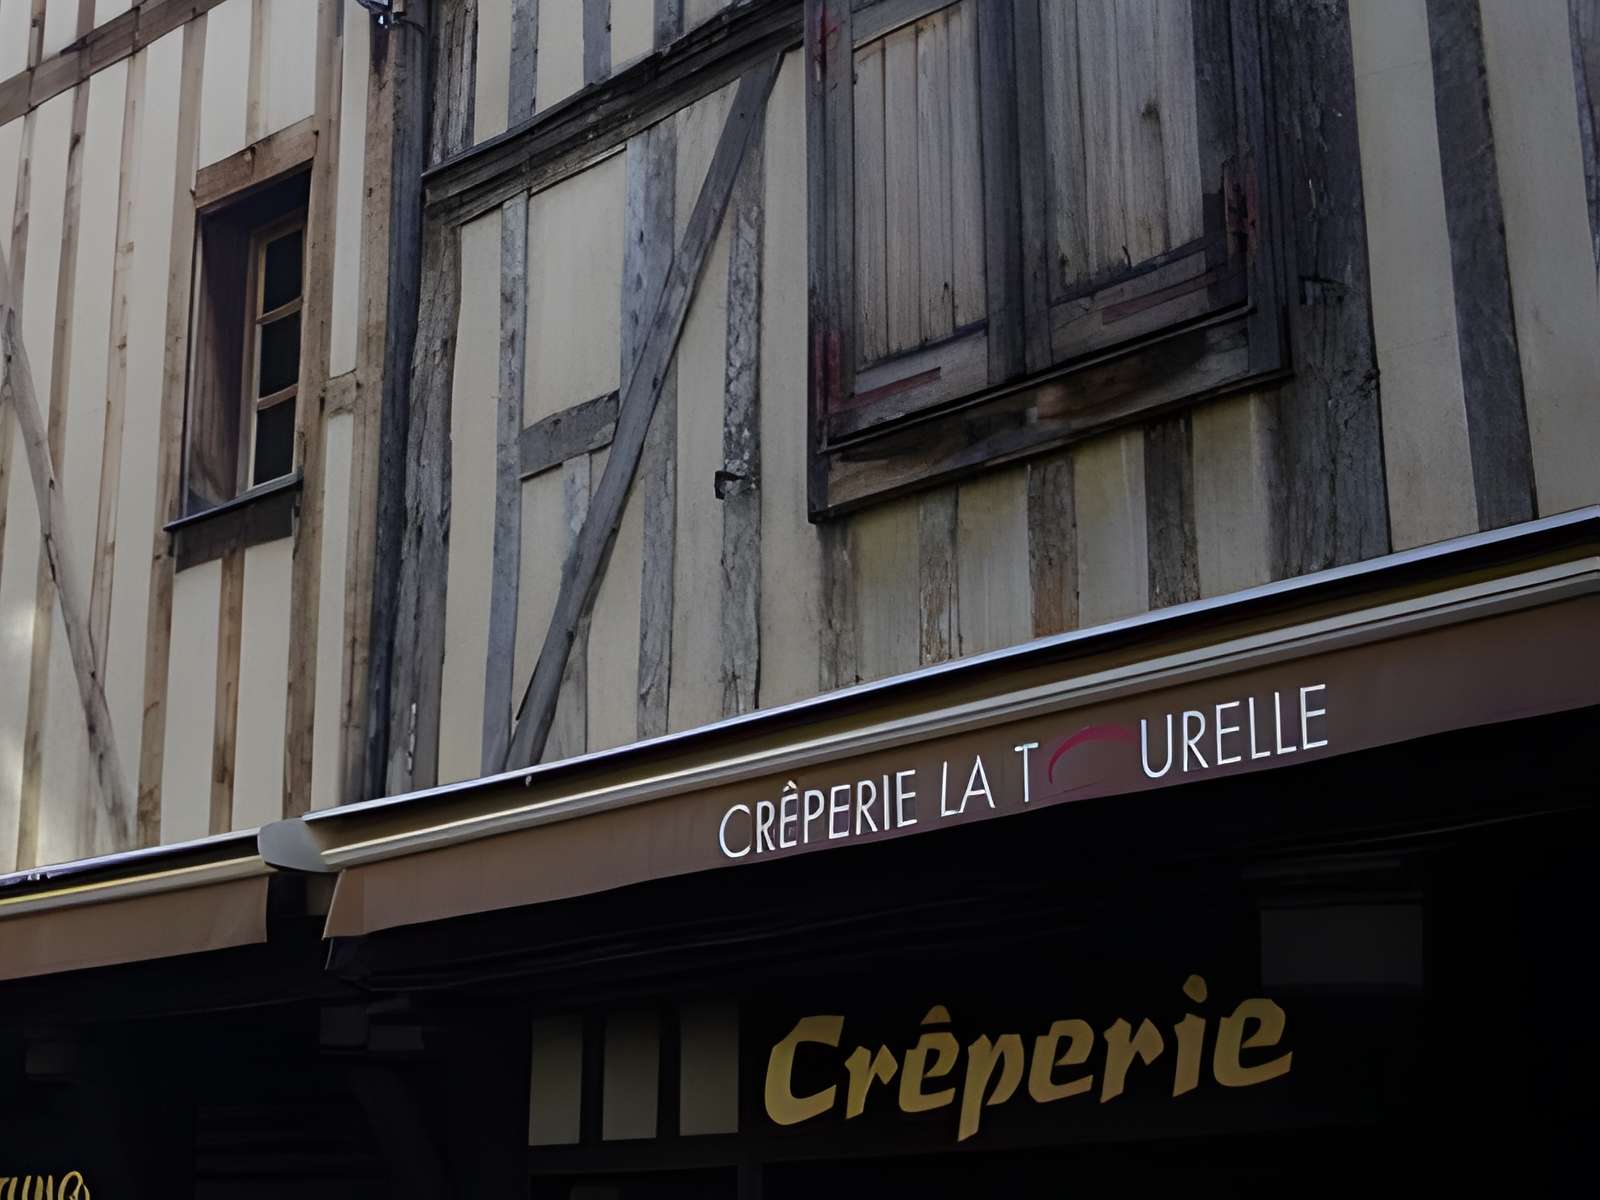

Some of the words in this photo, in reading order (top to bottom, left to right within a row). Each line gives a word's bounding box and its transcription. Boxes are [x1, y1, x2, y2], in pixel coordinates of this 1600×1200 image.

[718, 768, 918, 859] CRÊPERIE
[940, 754, 997, 818] LA
[763, 973, 1295, 1143] Crêperie
